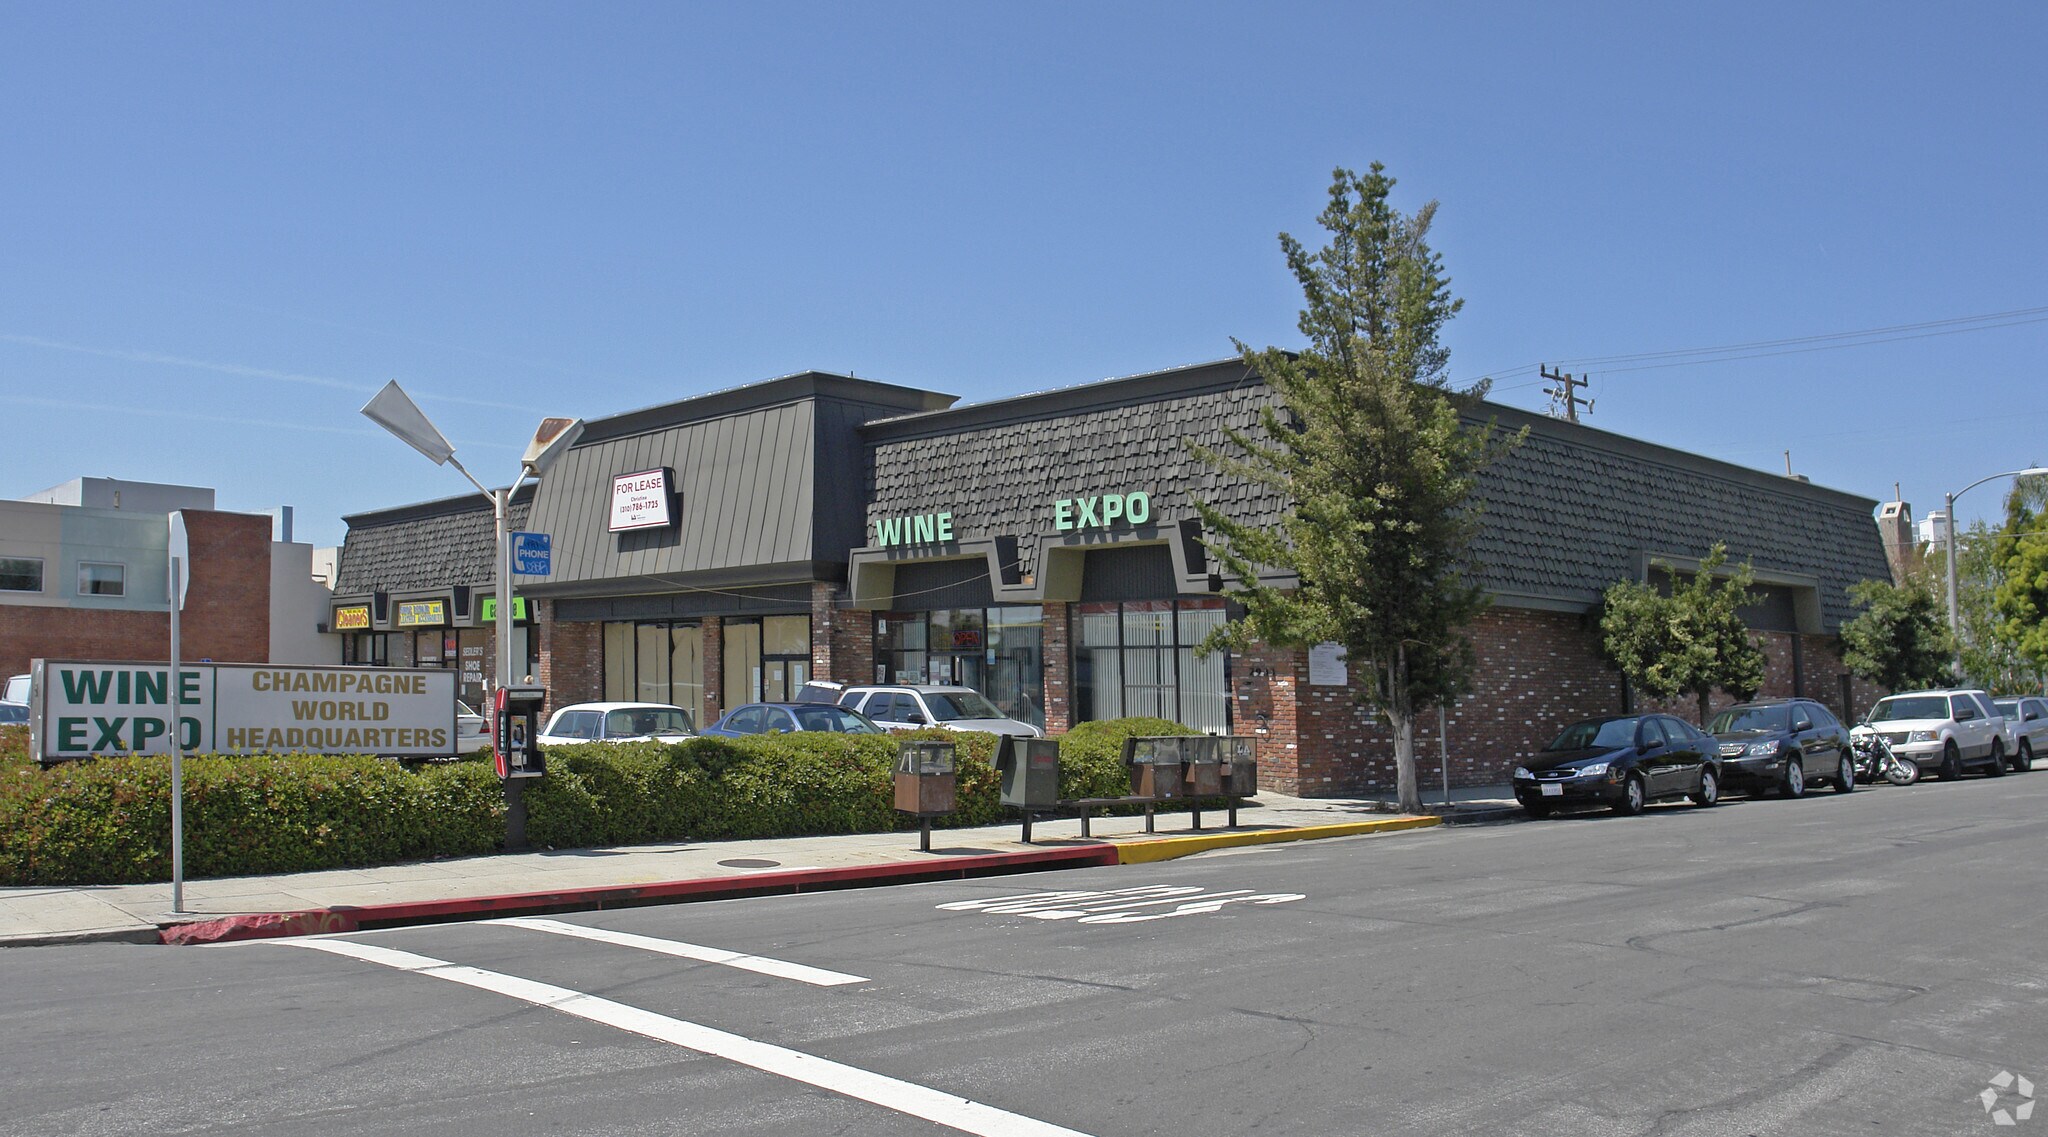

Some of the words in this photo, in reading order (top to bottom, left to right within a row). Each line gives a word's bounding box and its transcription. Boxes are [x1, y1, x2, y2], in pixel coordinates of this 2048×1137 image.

[617, 483, 633, 494] FOR
[635, 478, 662, 491] LEASE
[632, 500, 659, 511] 786-1725
[1055, 491, 1150, 530] EXPO
[876, 512, 954, 546] WINE
[520, 550, 549, 559] PHONE
[953, 632, 979, 645] OPEN
[465, 661, 480, 671] SHOE
[60, 670, 201, 705] WINE
[252, 671, 426, 695] CHAMPAGNE
[463, 673, 482, 682] REPAIR
[292, 701, 389, 721] WORLD
[58, 717, 201, 751] EXPO
[227, 727, 447, 749] HEADQUARTERS
